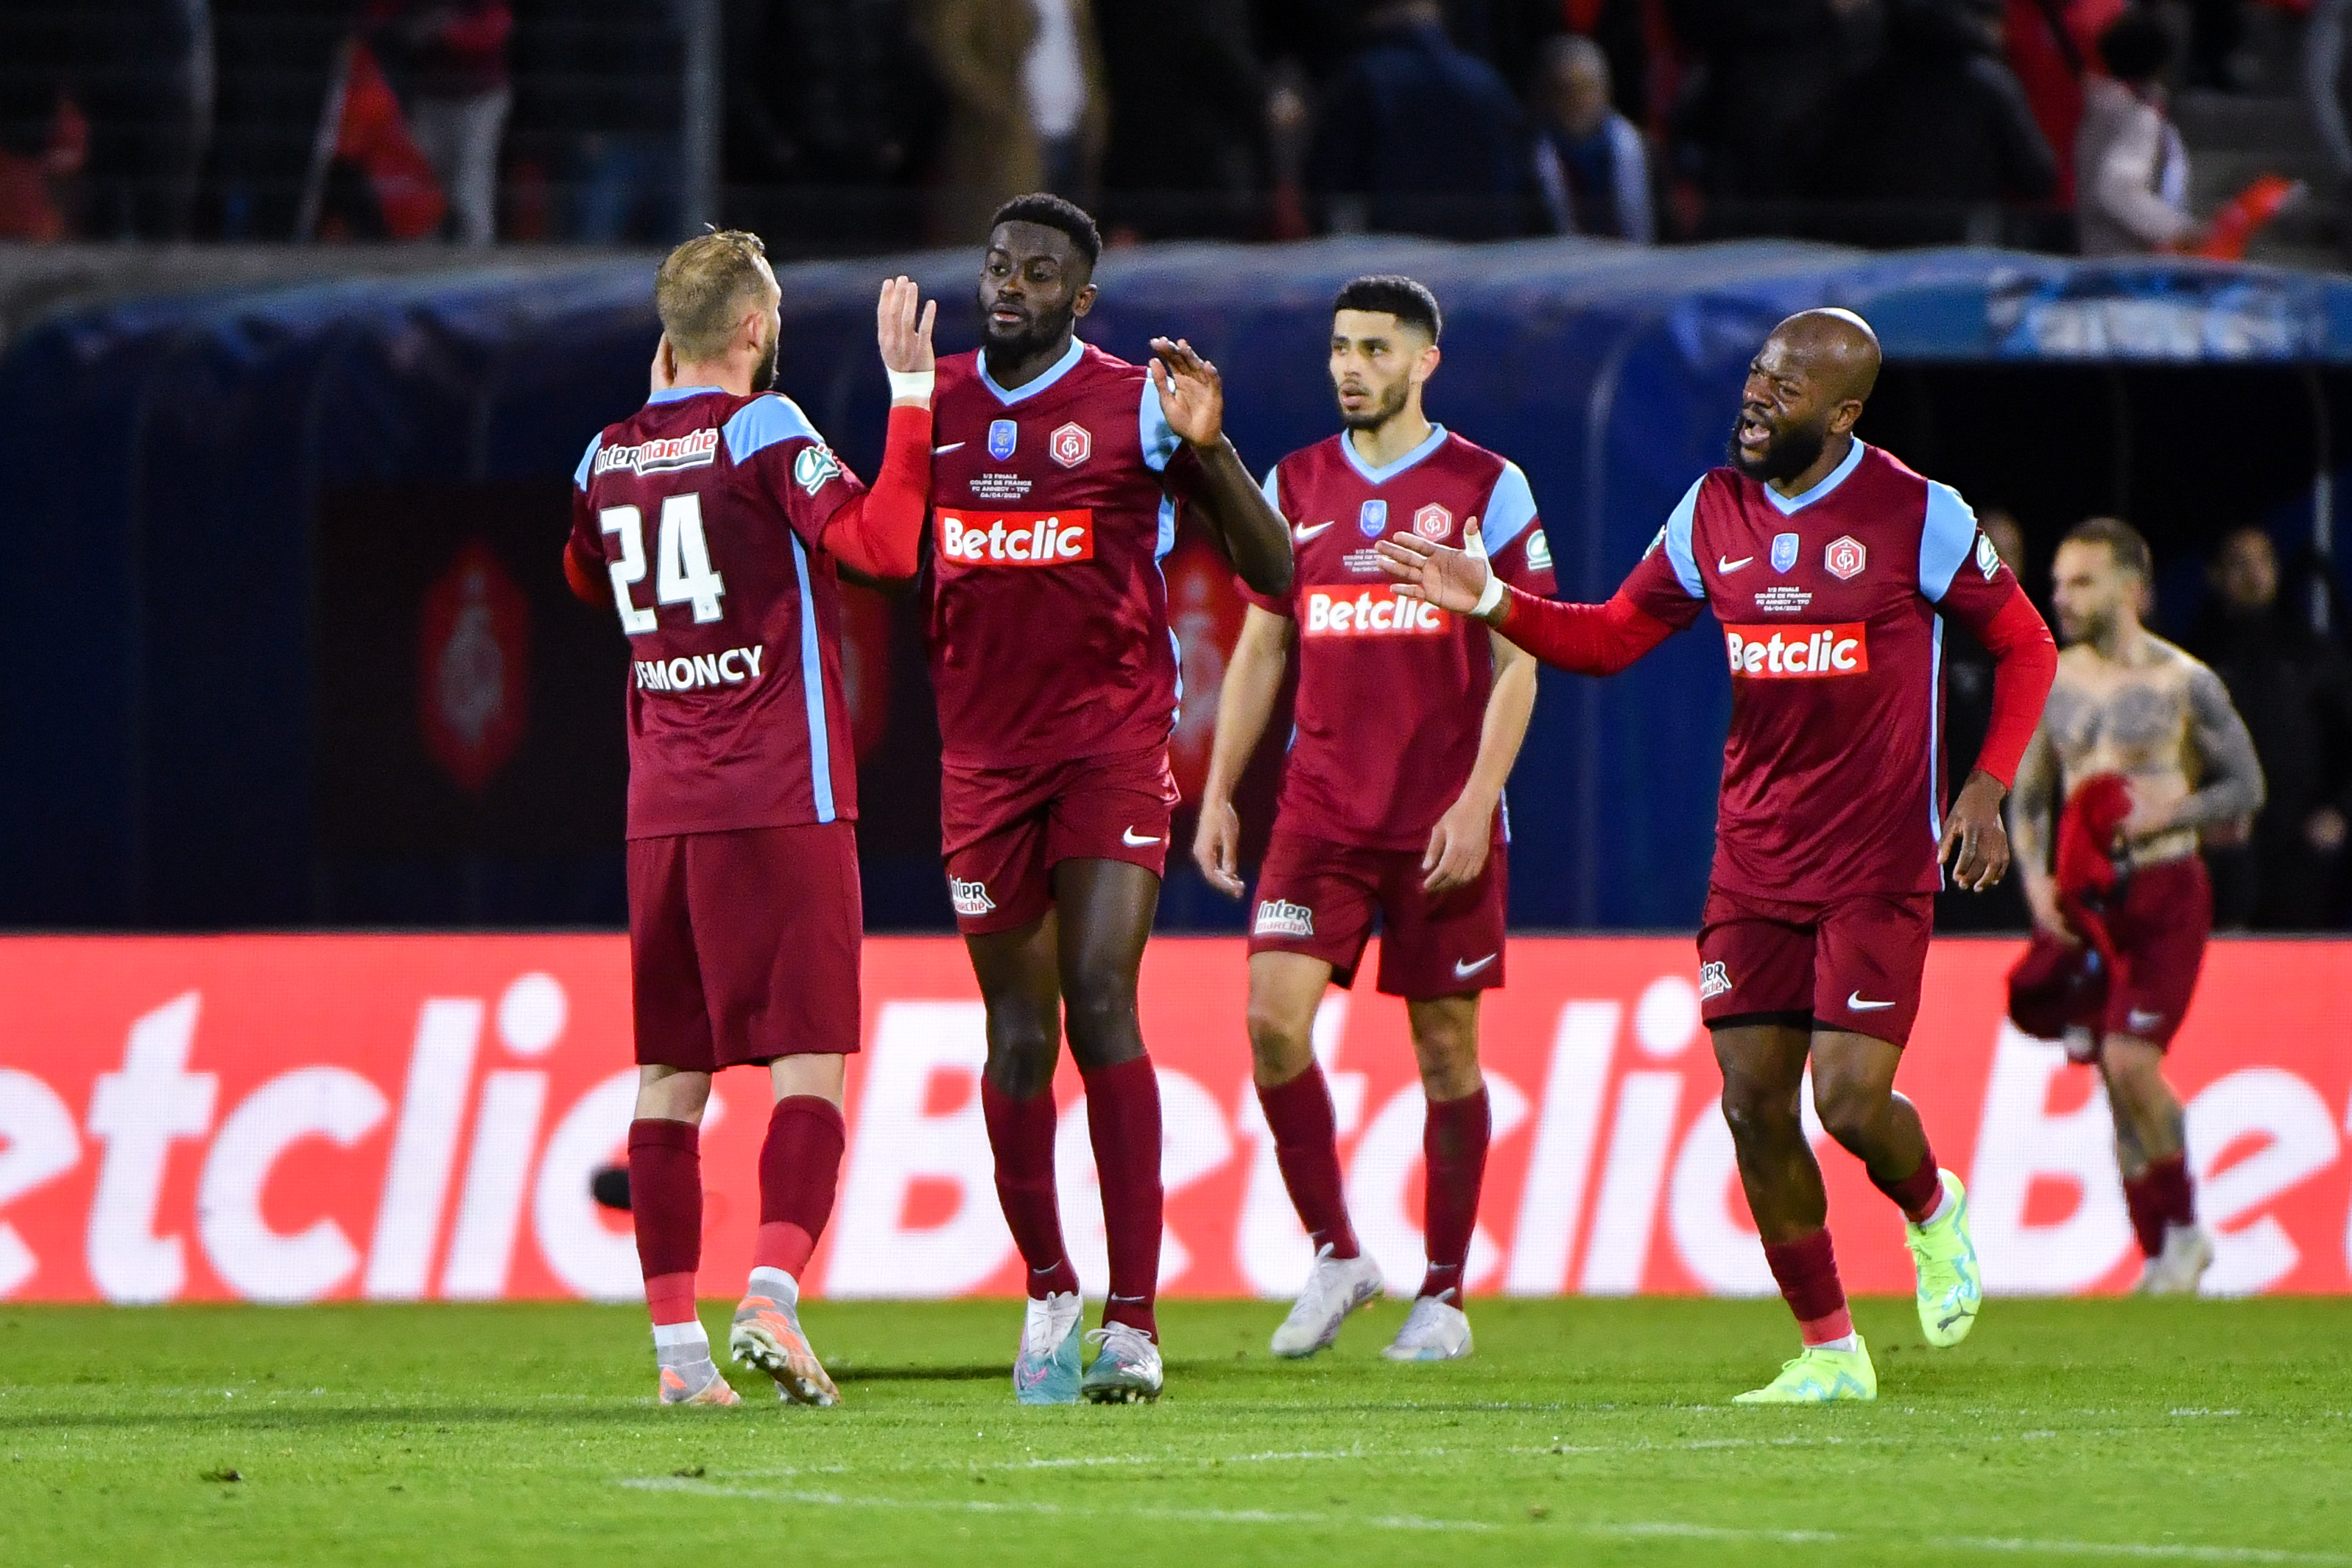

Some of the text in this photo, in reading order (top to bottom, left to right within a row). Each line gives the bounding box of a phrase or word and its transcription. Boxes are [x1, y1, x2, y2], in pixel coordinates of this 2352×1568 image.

[944, 516, 1085, 560] Betclic
[599, 492, 725, 635] 24
[1309, 591, 1440, 631] Betclic
[1728, 629, 1859, 674] Betclic
[951, 877, 993, 907] nter
[1969, 1013, 2352, 1299] Be
